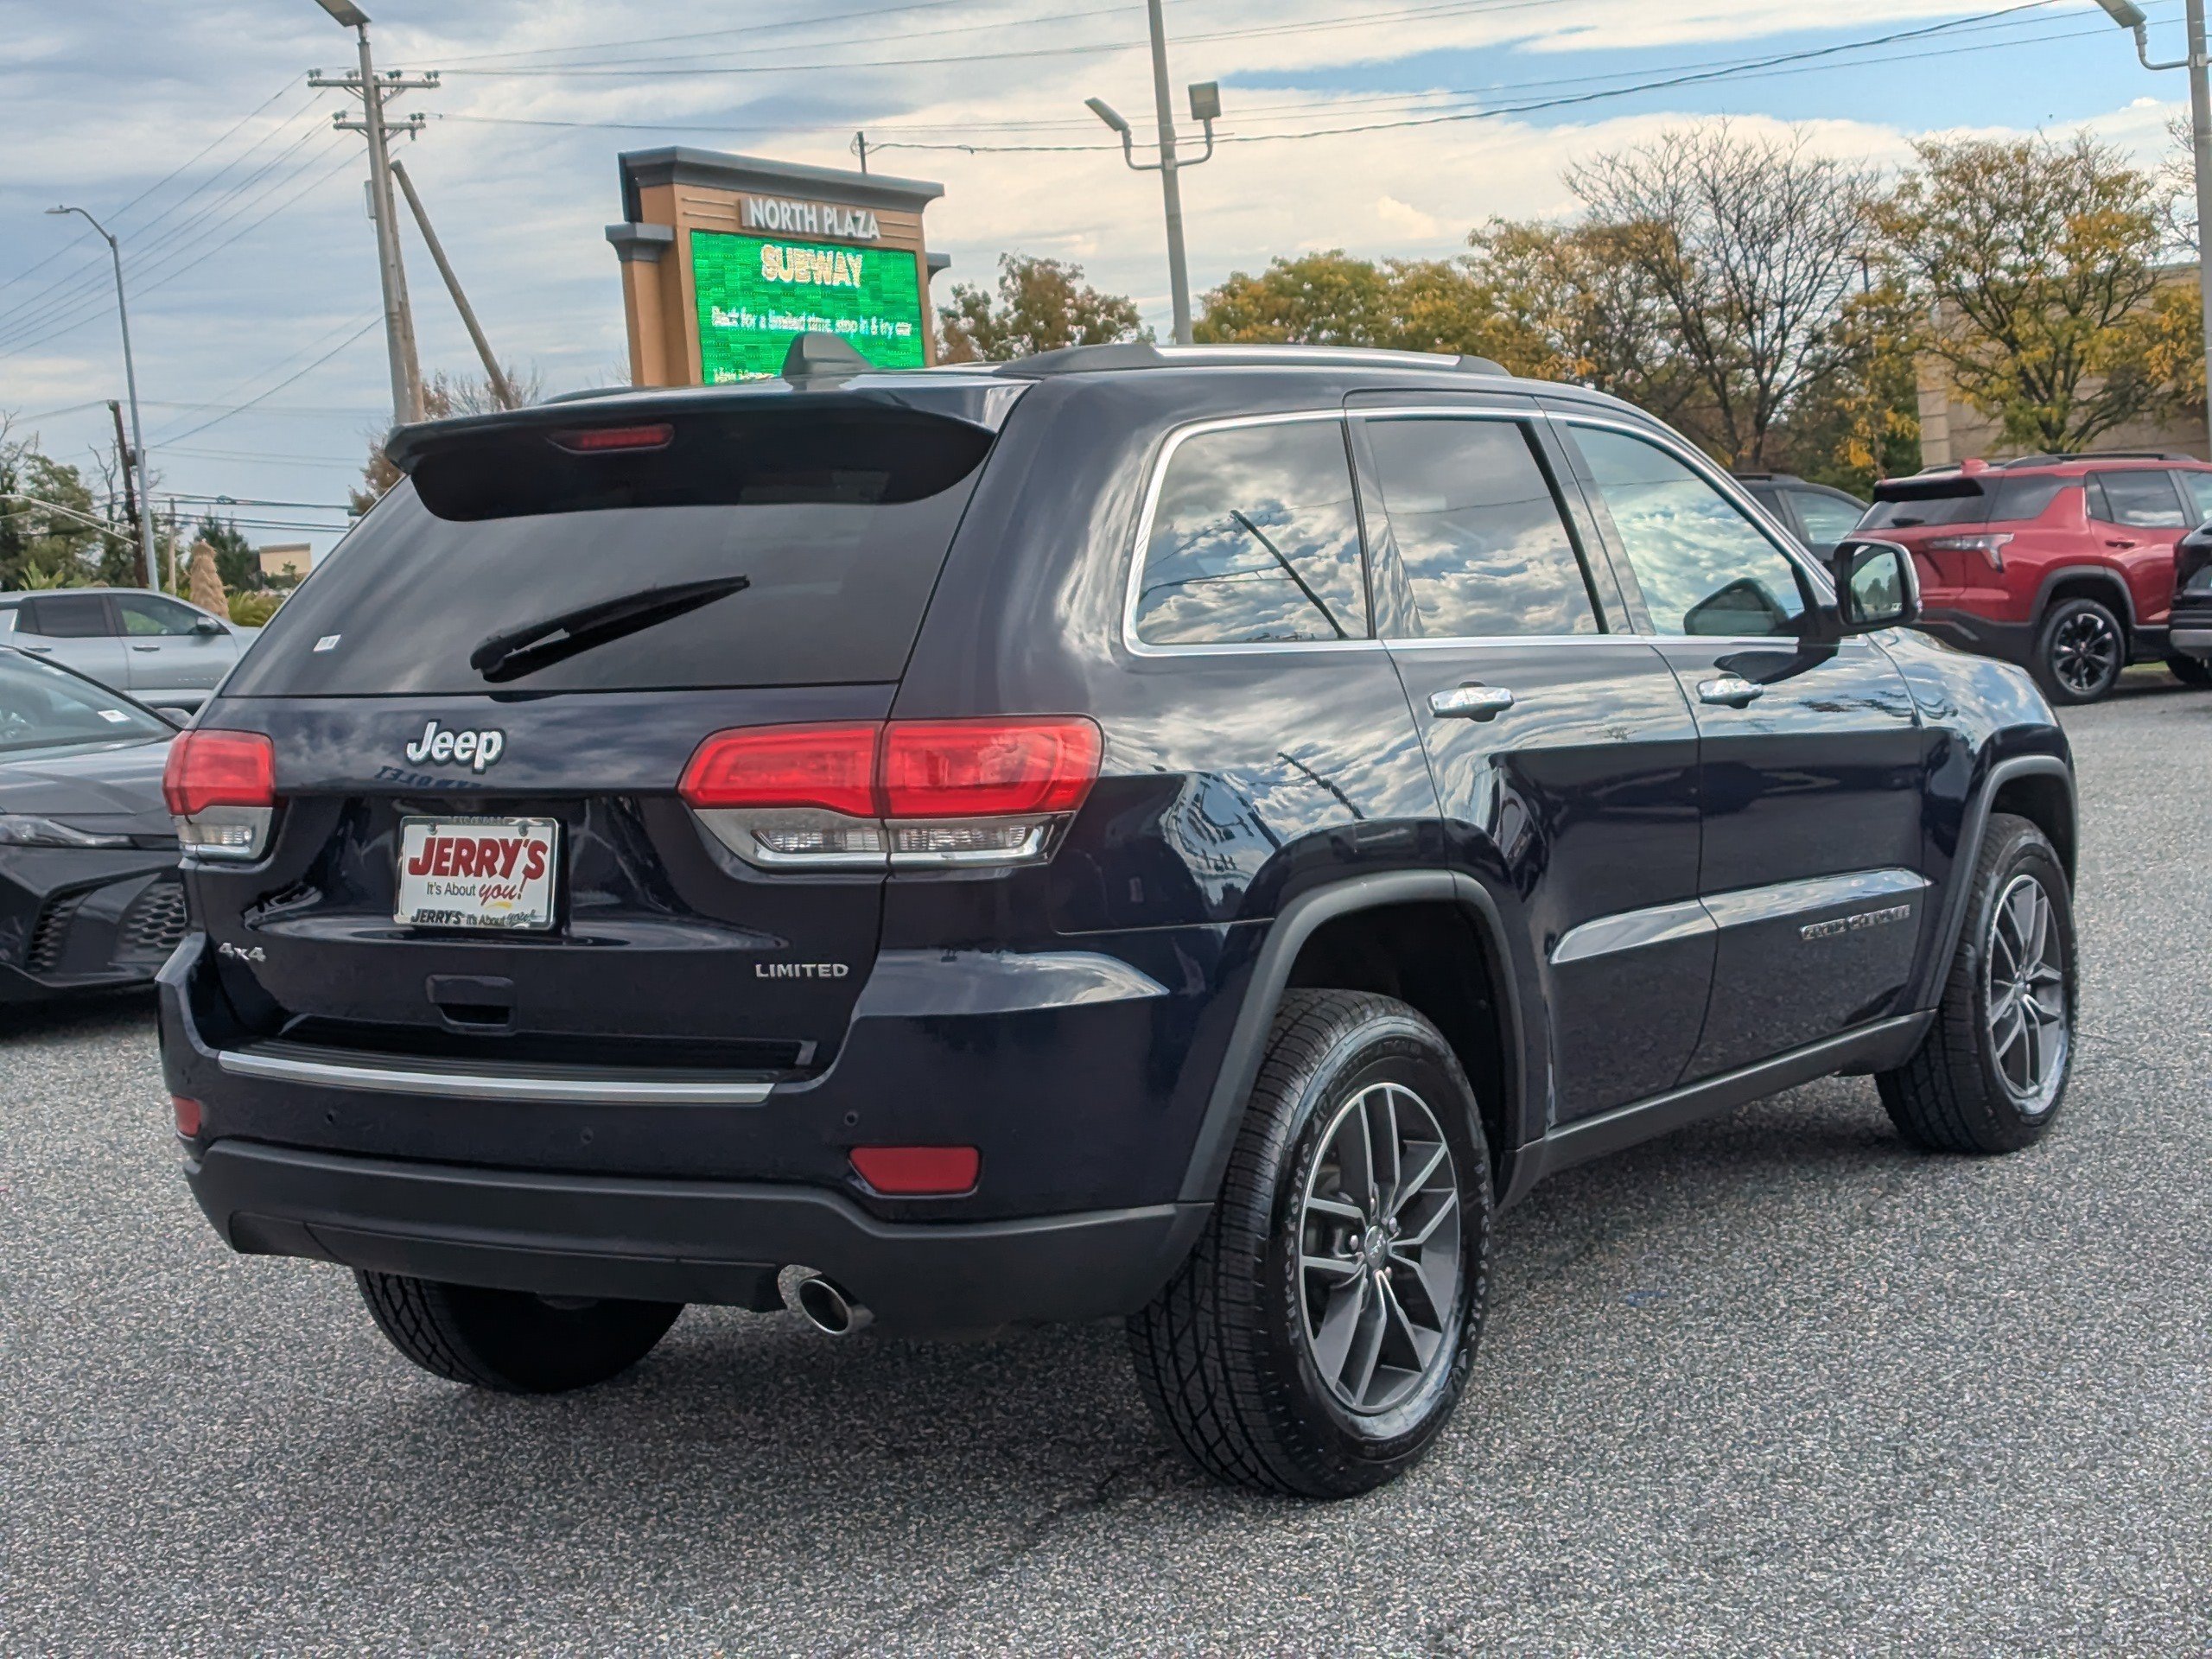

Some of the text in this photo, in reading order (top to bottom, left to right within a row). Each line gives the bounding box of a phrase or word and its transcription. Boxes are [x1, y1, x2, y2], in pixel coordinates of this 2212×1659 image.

[750, 198, 881, 239] NORTH PLAZA
[760, 244, 863, 287] SUBWAY
[406, 720, 505, 774] Jeep
[408, 836, 548, 880] JERRY'S
[427, 876, 527, 906] It's About you!
[410, 908, 463, 925] JERRY'S
[479, 914, 505, 926] About
[219, 943, 266, 962] 4x4
[755, 963, 849, 977] LIMITED
